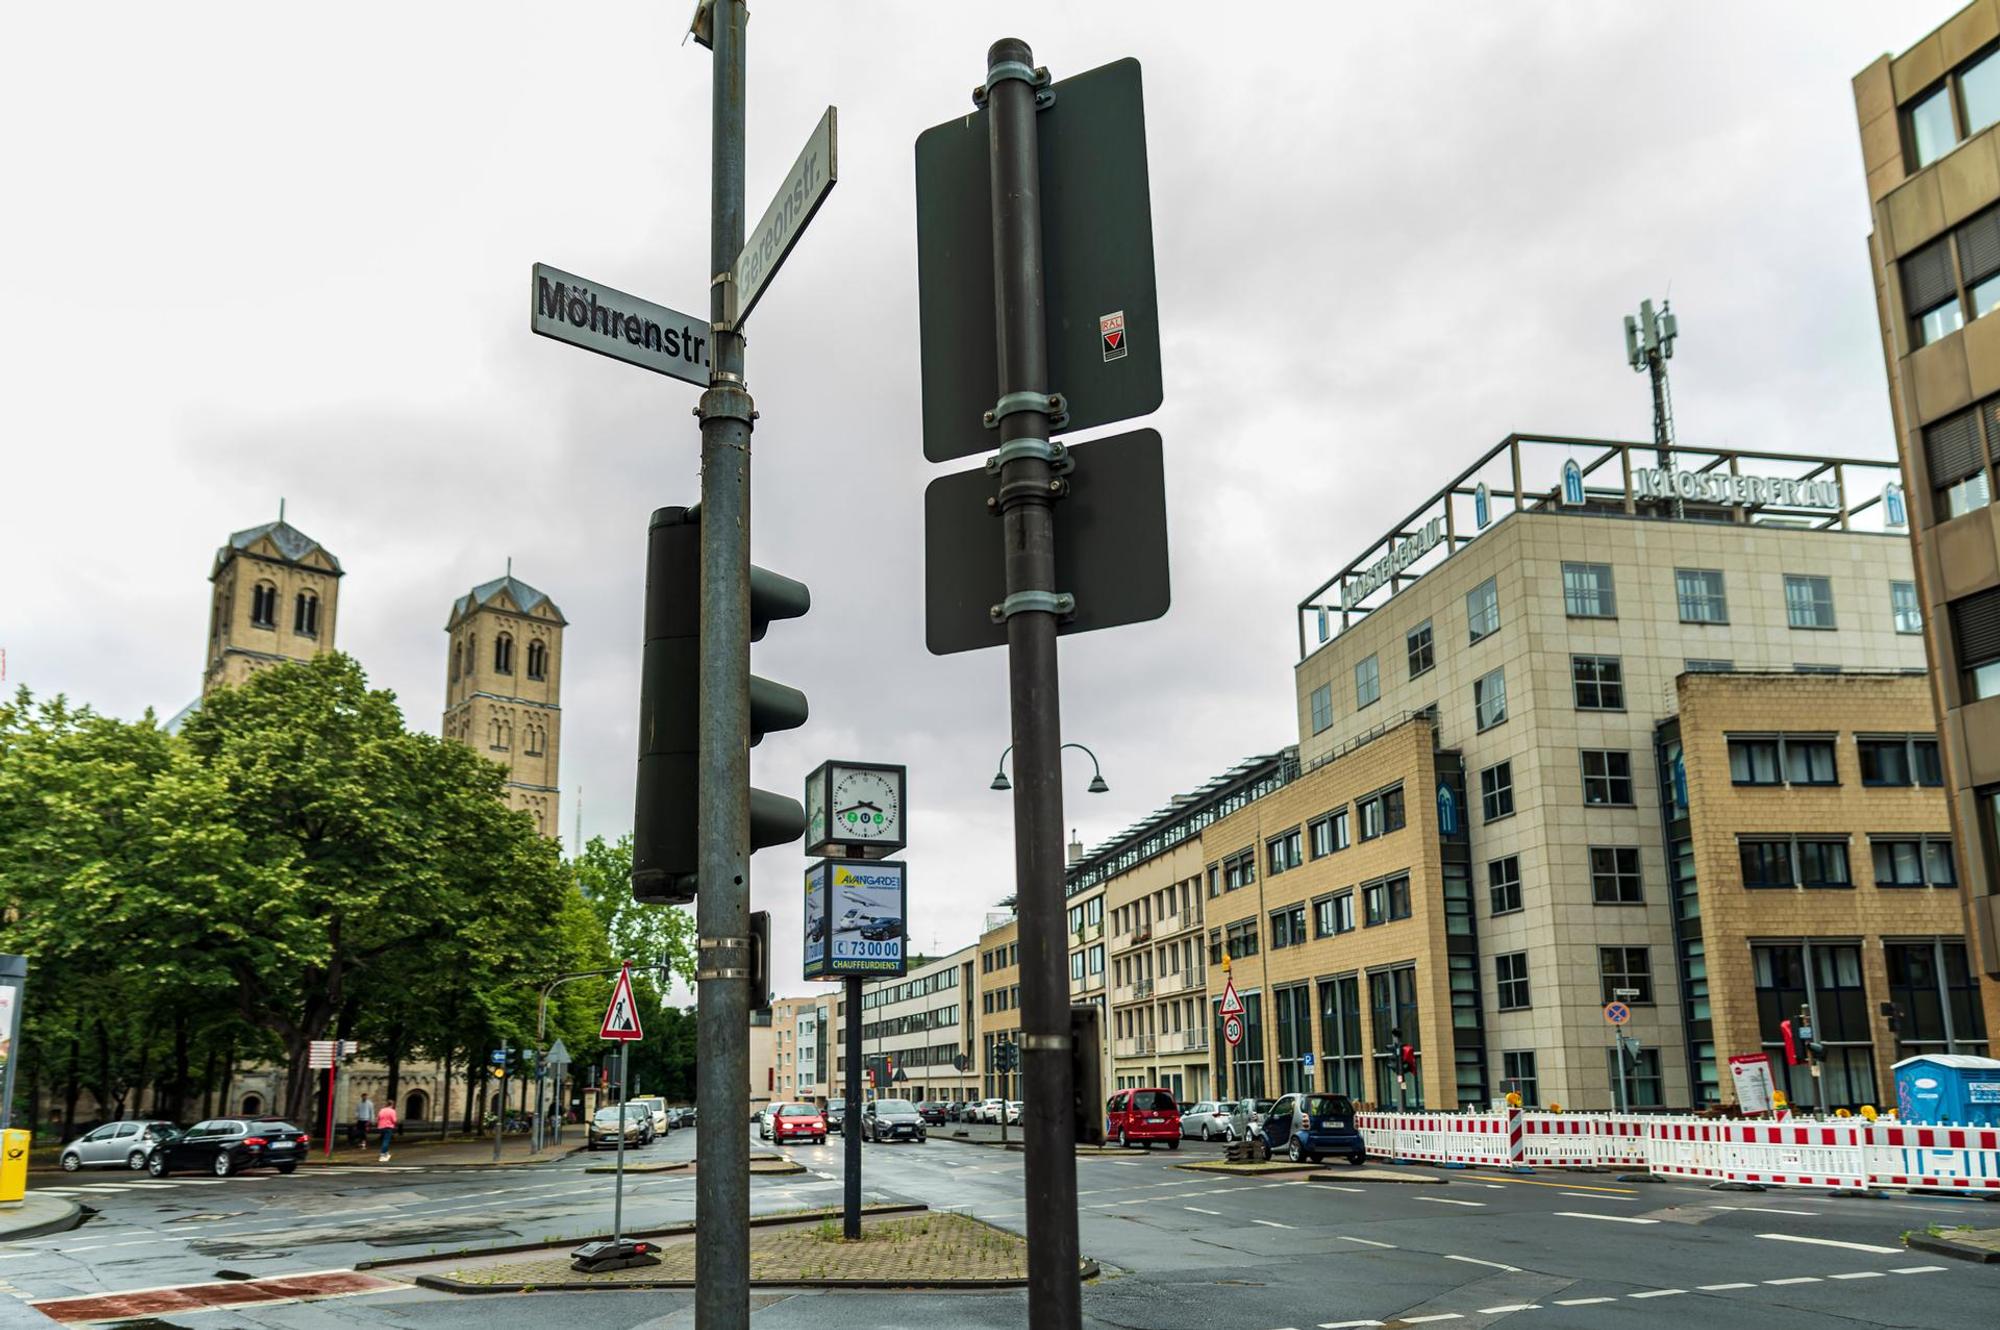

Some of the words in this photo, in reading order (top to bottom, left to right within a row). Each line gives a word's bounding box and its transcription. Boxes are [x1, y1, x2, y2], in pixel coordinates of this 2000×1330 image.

[740, 152, 820, 299] Gereonstr.
[538, 275, 710, 368] Möhrenstr.
[1638, 467, 1840, 509] KLOSTERFRAU
[1341, 516, 1441, 611] KLOSTERFRAU
[841, 875, 897, 887] AVANGARDE
[851, 941, 866, 956] 73
[868, 942, 882, 956] 00
[884, 942, 899, 957] 00
[832, 960, 901, 970] CHAUFFEURDIENST
[1227, 1023, 1239, 1037] 30
